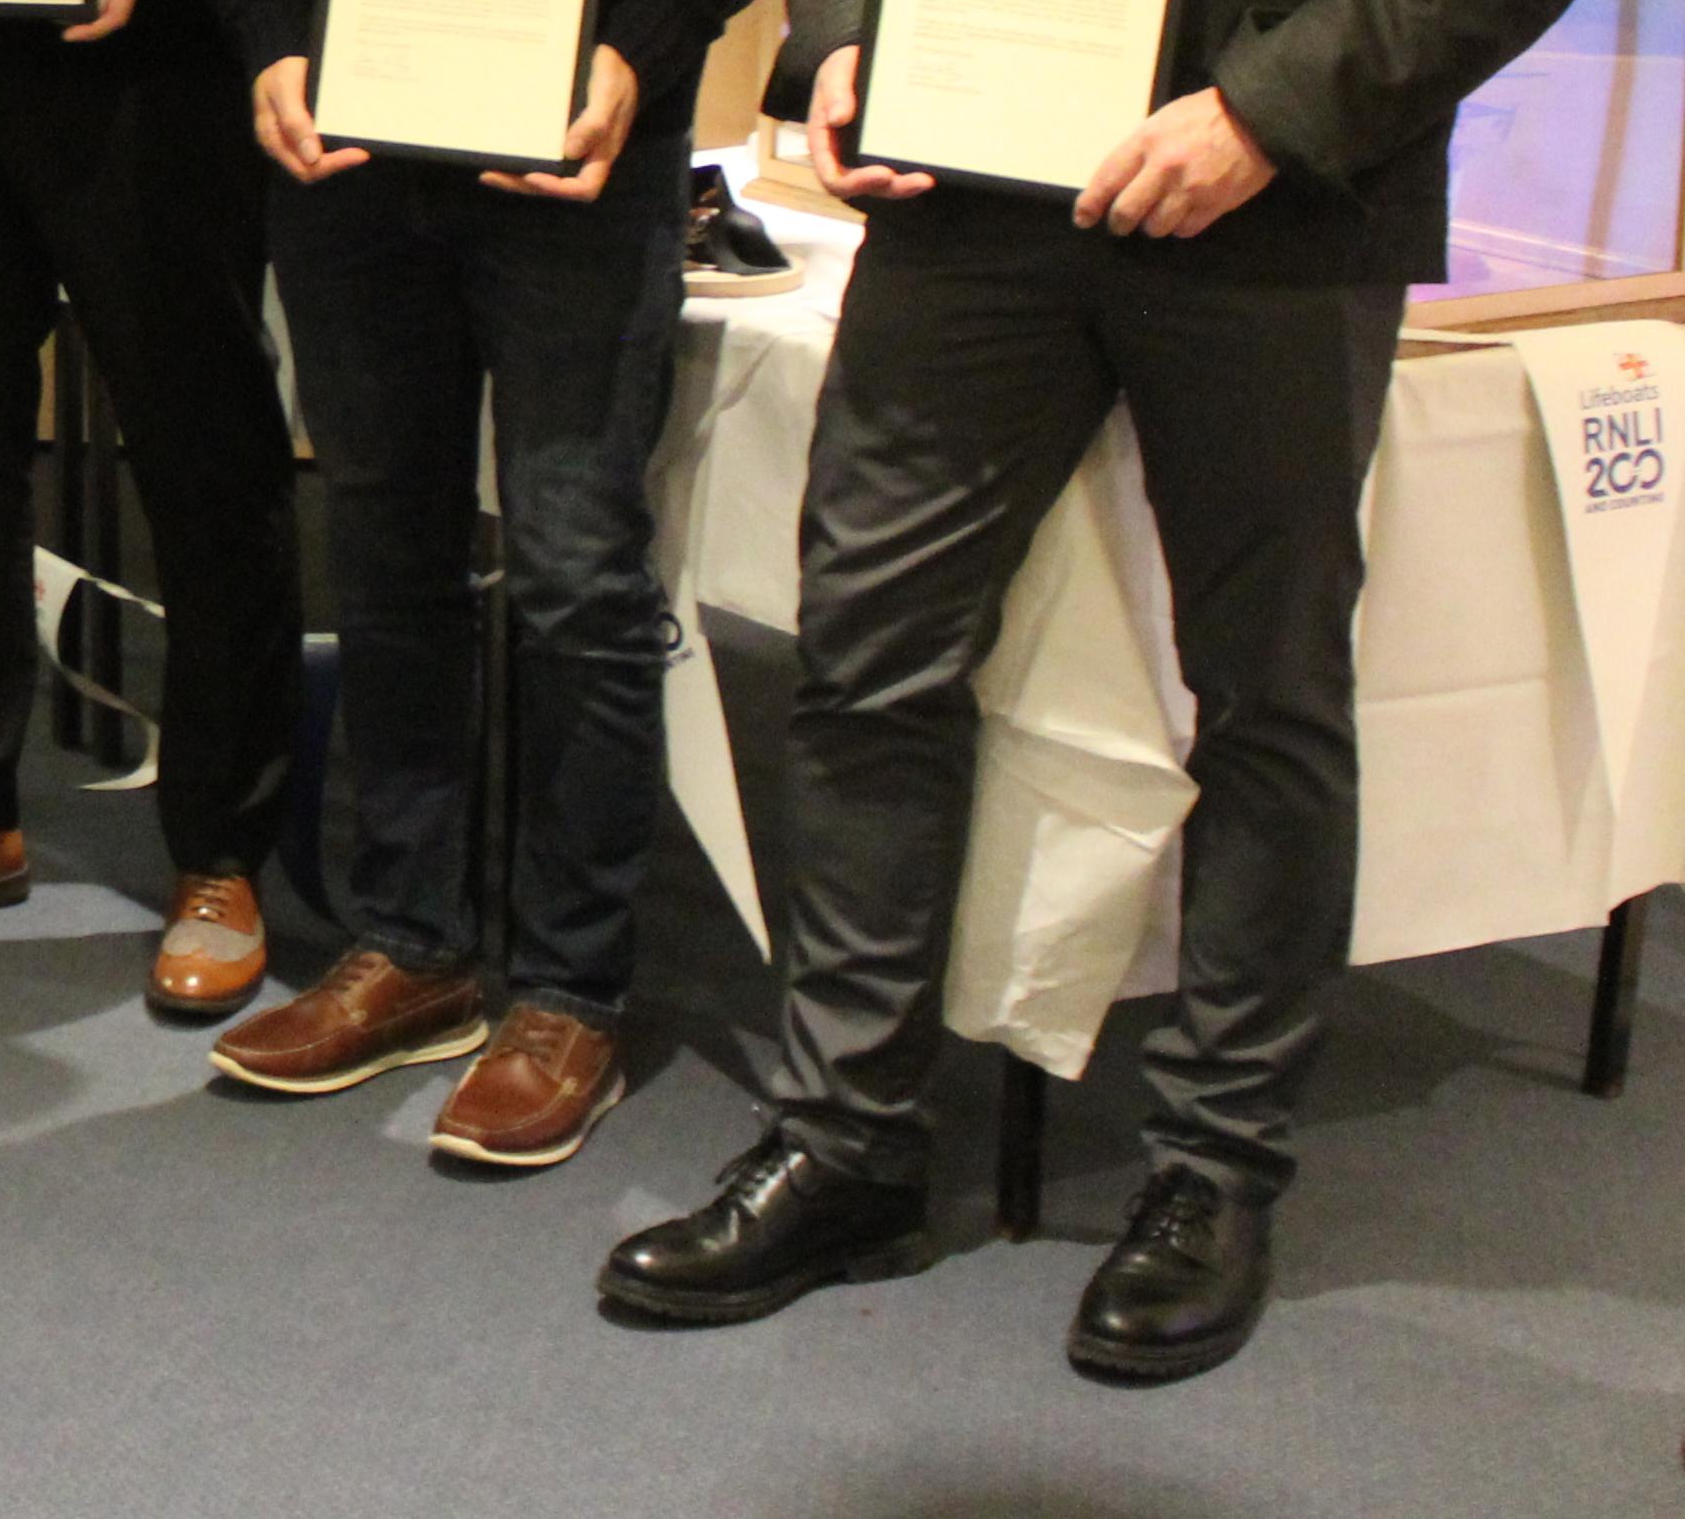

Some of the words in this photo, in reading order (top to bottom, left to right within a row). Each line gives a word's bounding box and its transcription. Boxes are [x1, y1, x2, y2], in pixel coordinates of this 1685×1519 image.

[1579, 384, 1660, 410] Lifeboats
[1582, 407, 1662, 454] RNLI
[1585, 448, 1664, 498] 200
